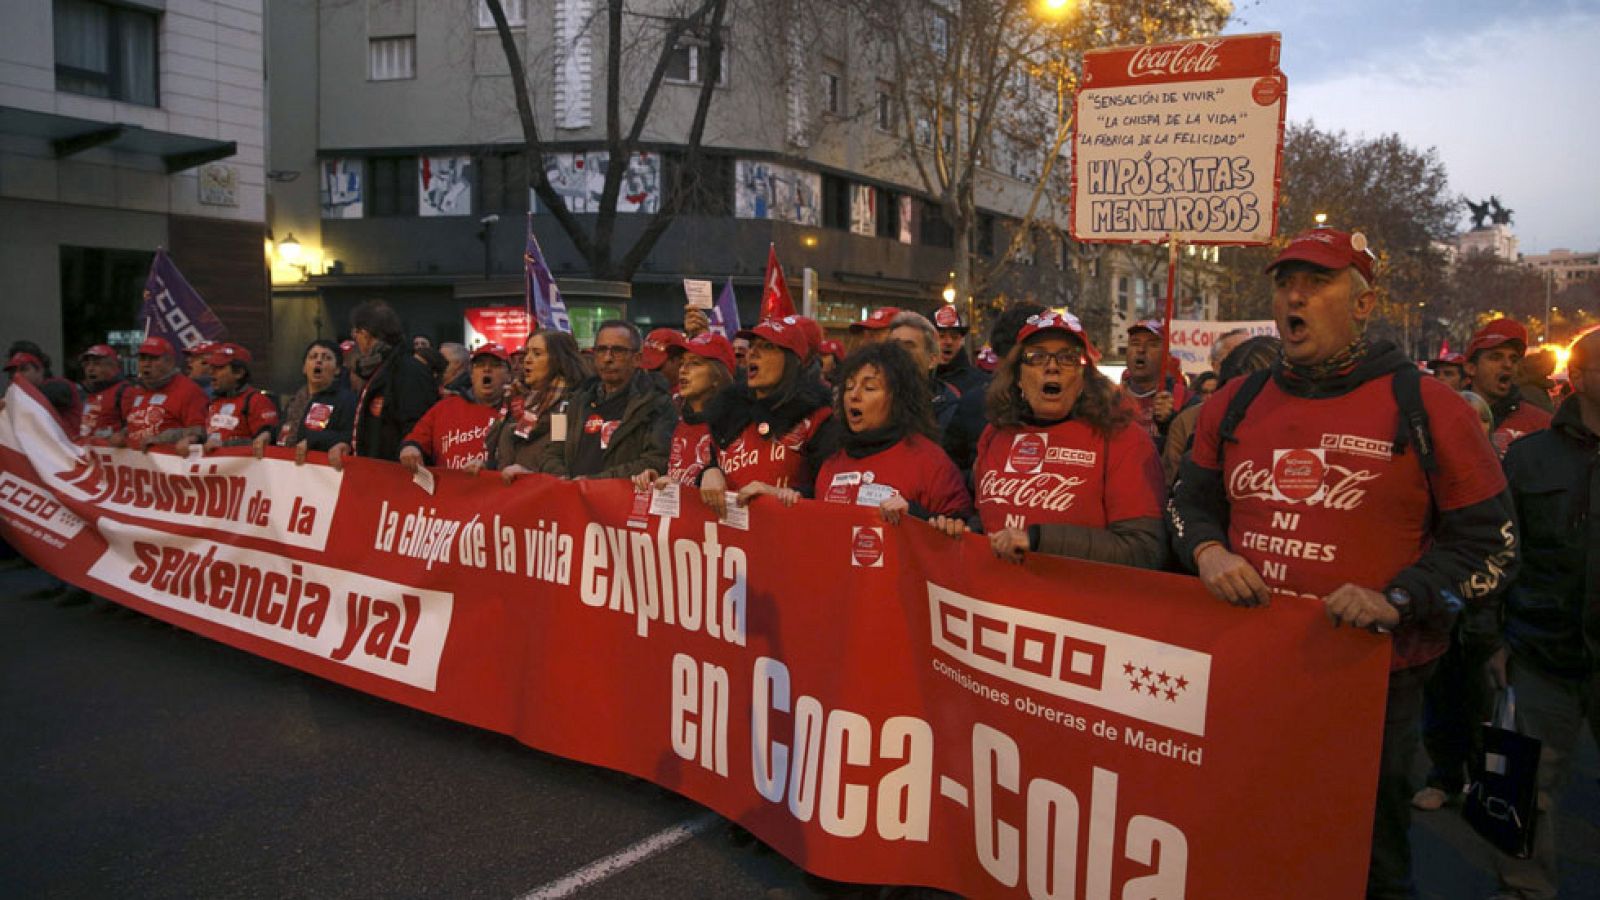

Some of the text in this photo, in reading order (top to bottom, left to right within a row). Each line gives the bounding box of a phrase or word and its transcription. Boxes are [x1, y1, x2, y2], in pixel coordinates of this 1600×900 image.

[1162, 92, 1178, 104] DE
[1165, 113, 1179, 125] DE
[1186, 113, 1201, 125] LA
[1154, 133, 1169, 145] LA
[1088, 150, 1255, 195] HIPÓCRITAS
[1091, 191, 1260, 233] MENTIROSOS
[156, 275, 206, 349] COO
[770, 441, 785, 462] la
[247, 490, 272, 527] de
[287, 496, 316, 537] la
[1005, 513, 1026, 531] NI
[1271, 511, 1301, 532] NI
[375, 501, 748, 648] La chispa de la vida explota
[1262, 559, 1288, 582] NI
[129, 540, 422, 667] sentencia ya!
[938, 599, 1107, 692] CCOO
[931, 656, 1203, 767] comisiones obreras de Madrid
[671, 651, 1189, 900] en Coca-Cola
